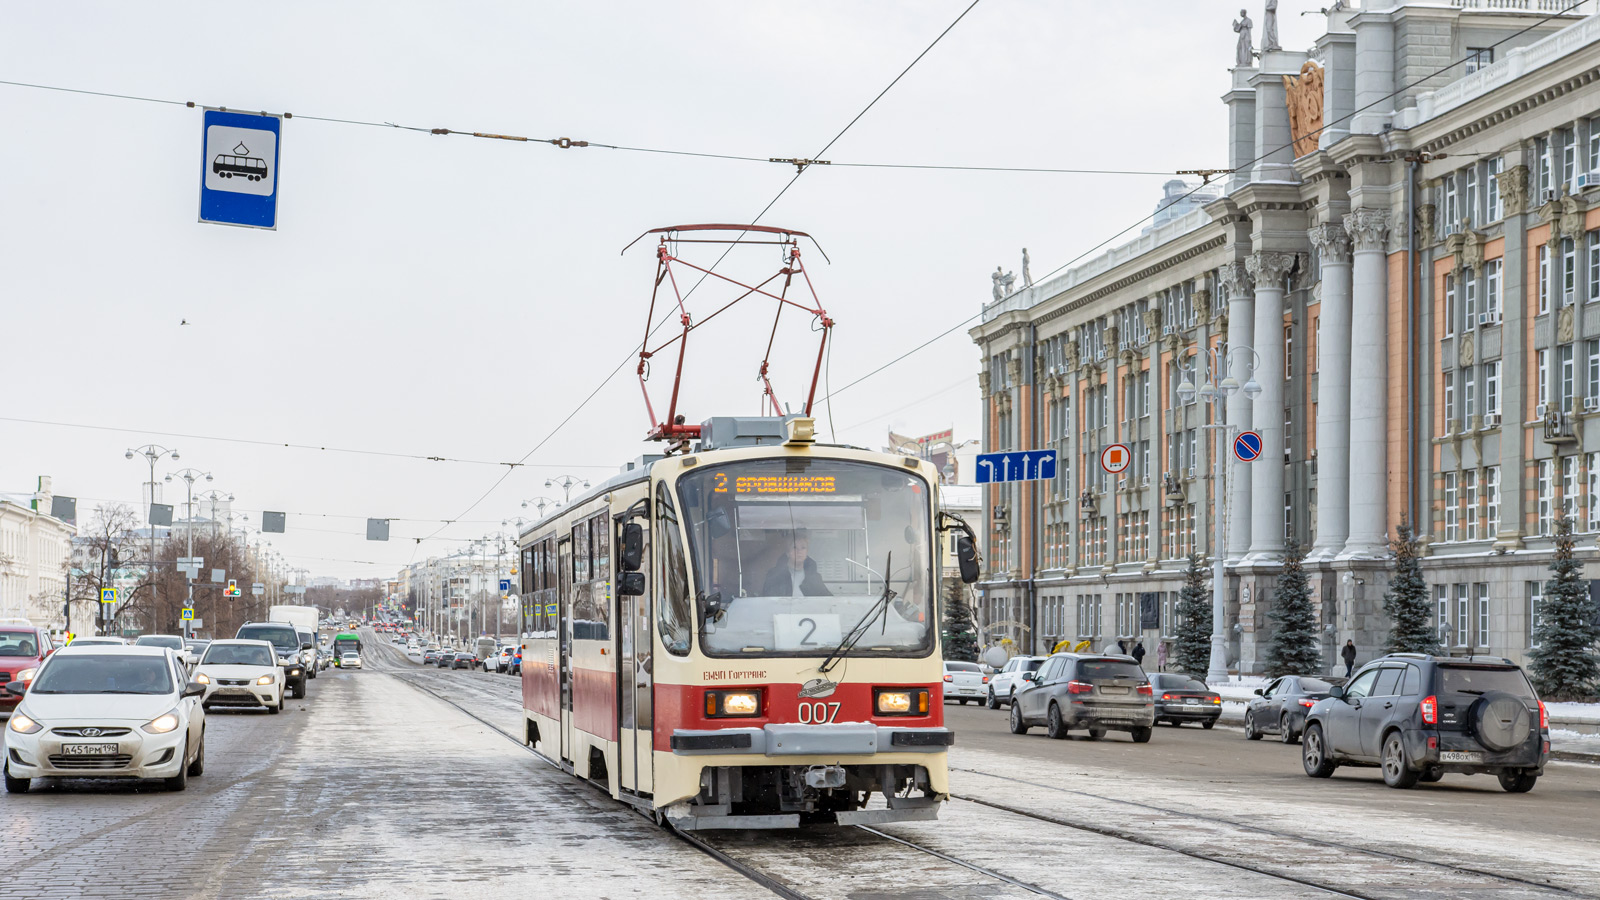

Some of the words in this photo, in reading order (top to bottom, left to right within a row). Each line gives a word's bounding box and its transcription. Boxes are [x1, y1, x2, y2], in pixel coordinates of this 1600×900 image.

[714, 473, 728, 492] 2
[799, 617, 818, 646] 2
[798, 702, 841, 724] 007
